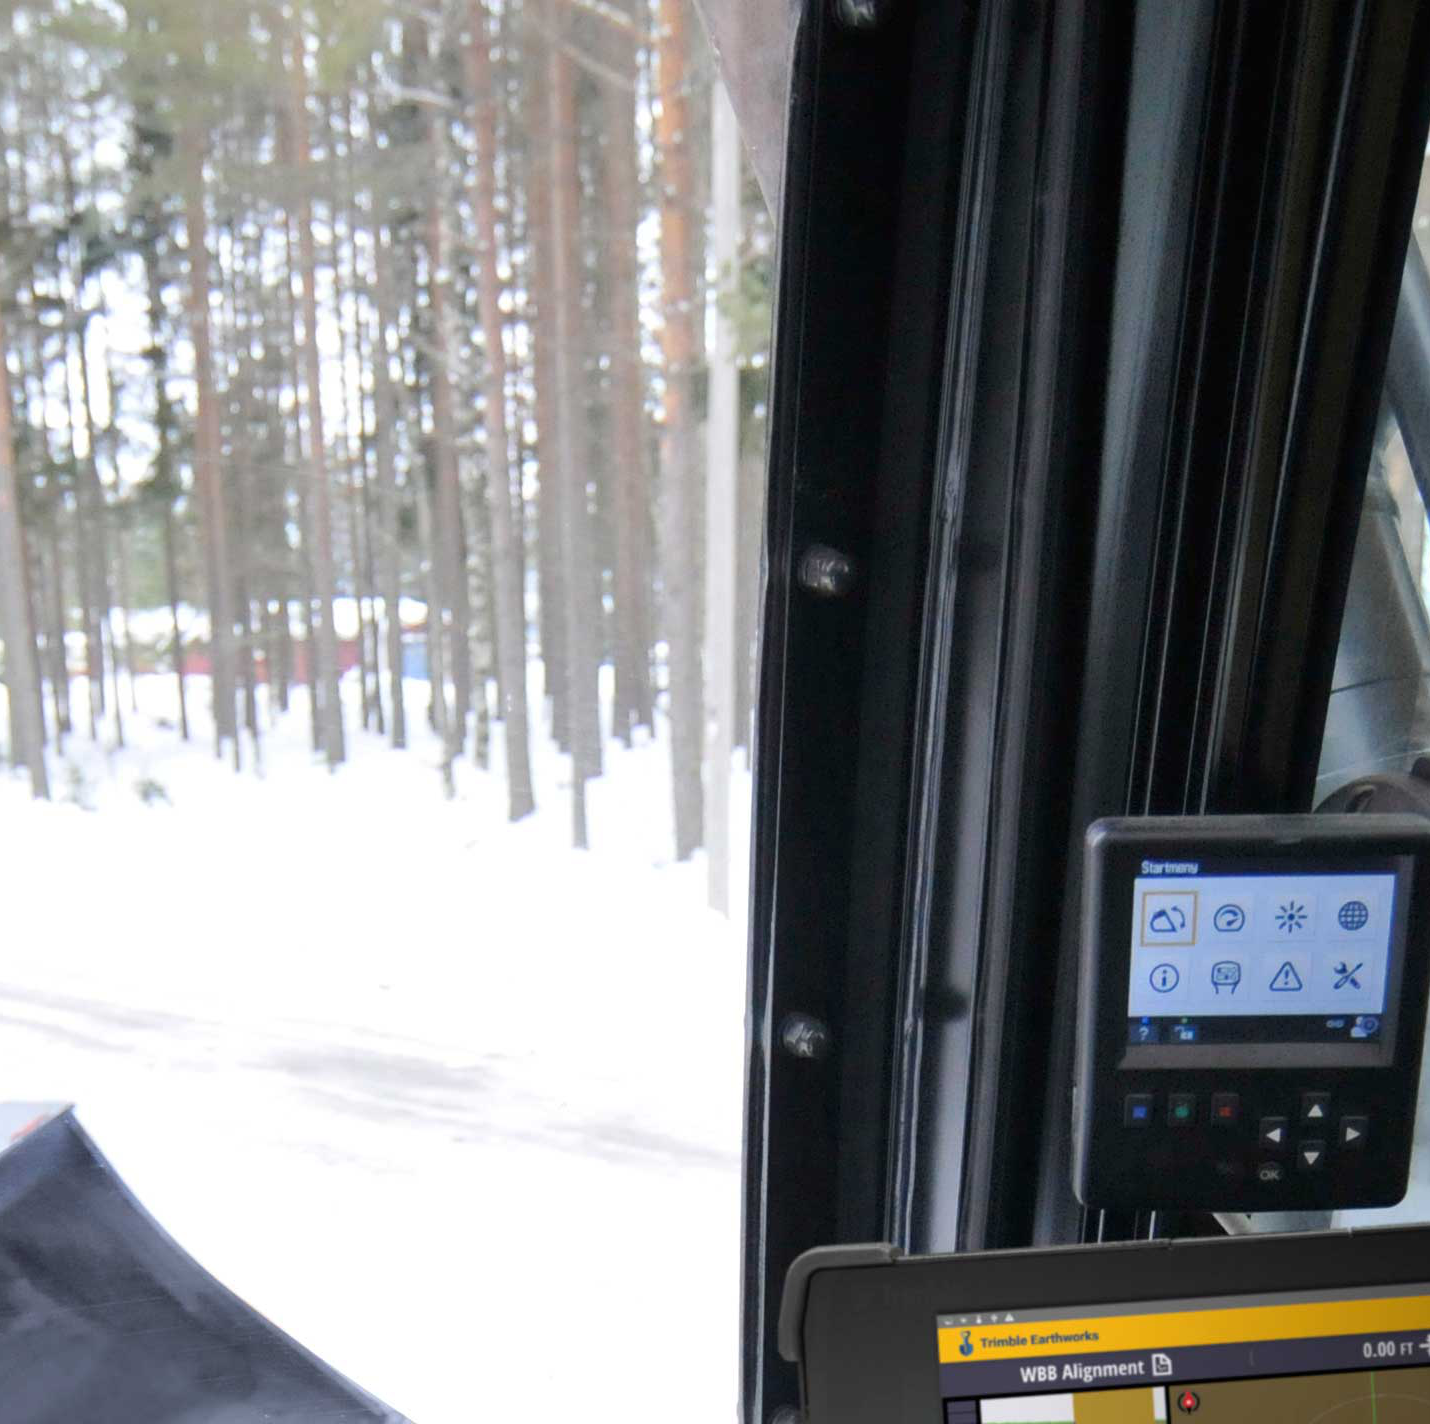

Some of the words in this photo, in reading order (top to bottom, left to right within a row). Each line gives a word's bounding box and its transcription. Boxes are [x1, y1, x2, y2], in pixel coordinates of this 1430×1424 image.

[980, 1335, 1027, 1349] Trimble
[1030, 1330, 1100, 1345] Earthworks
[1363, 1340, 1396, 1359] 0.00
[1399, 1341, 1414, 1356] FT
[1020, 1364, 1058, 1383] WBB
[1062, 1360, 1146, 1383] Alignment
